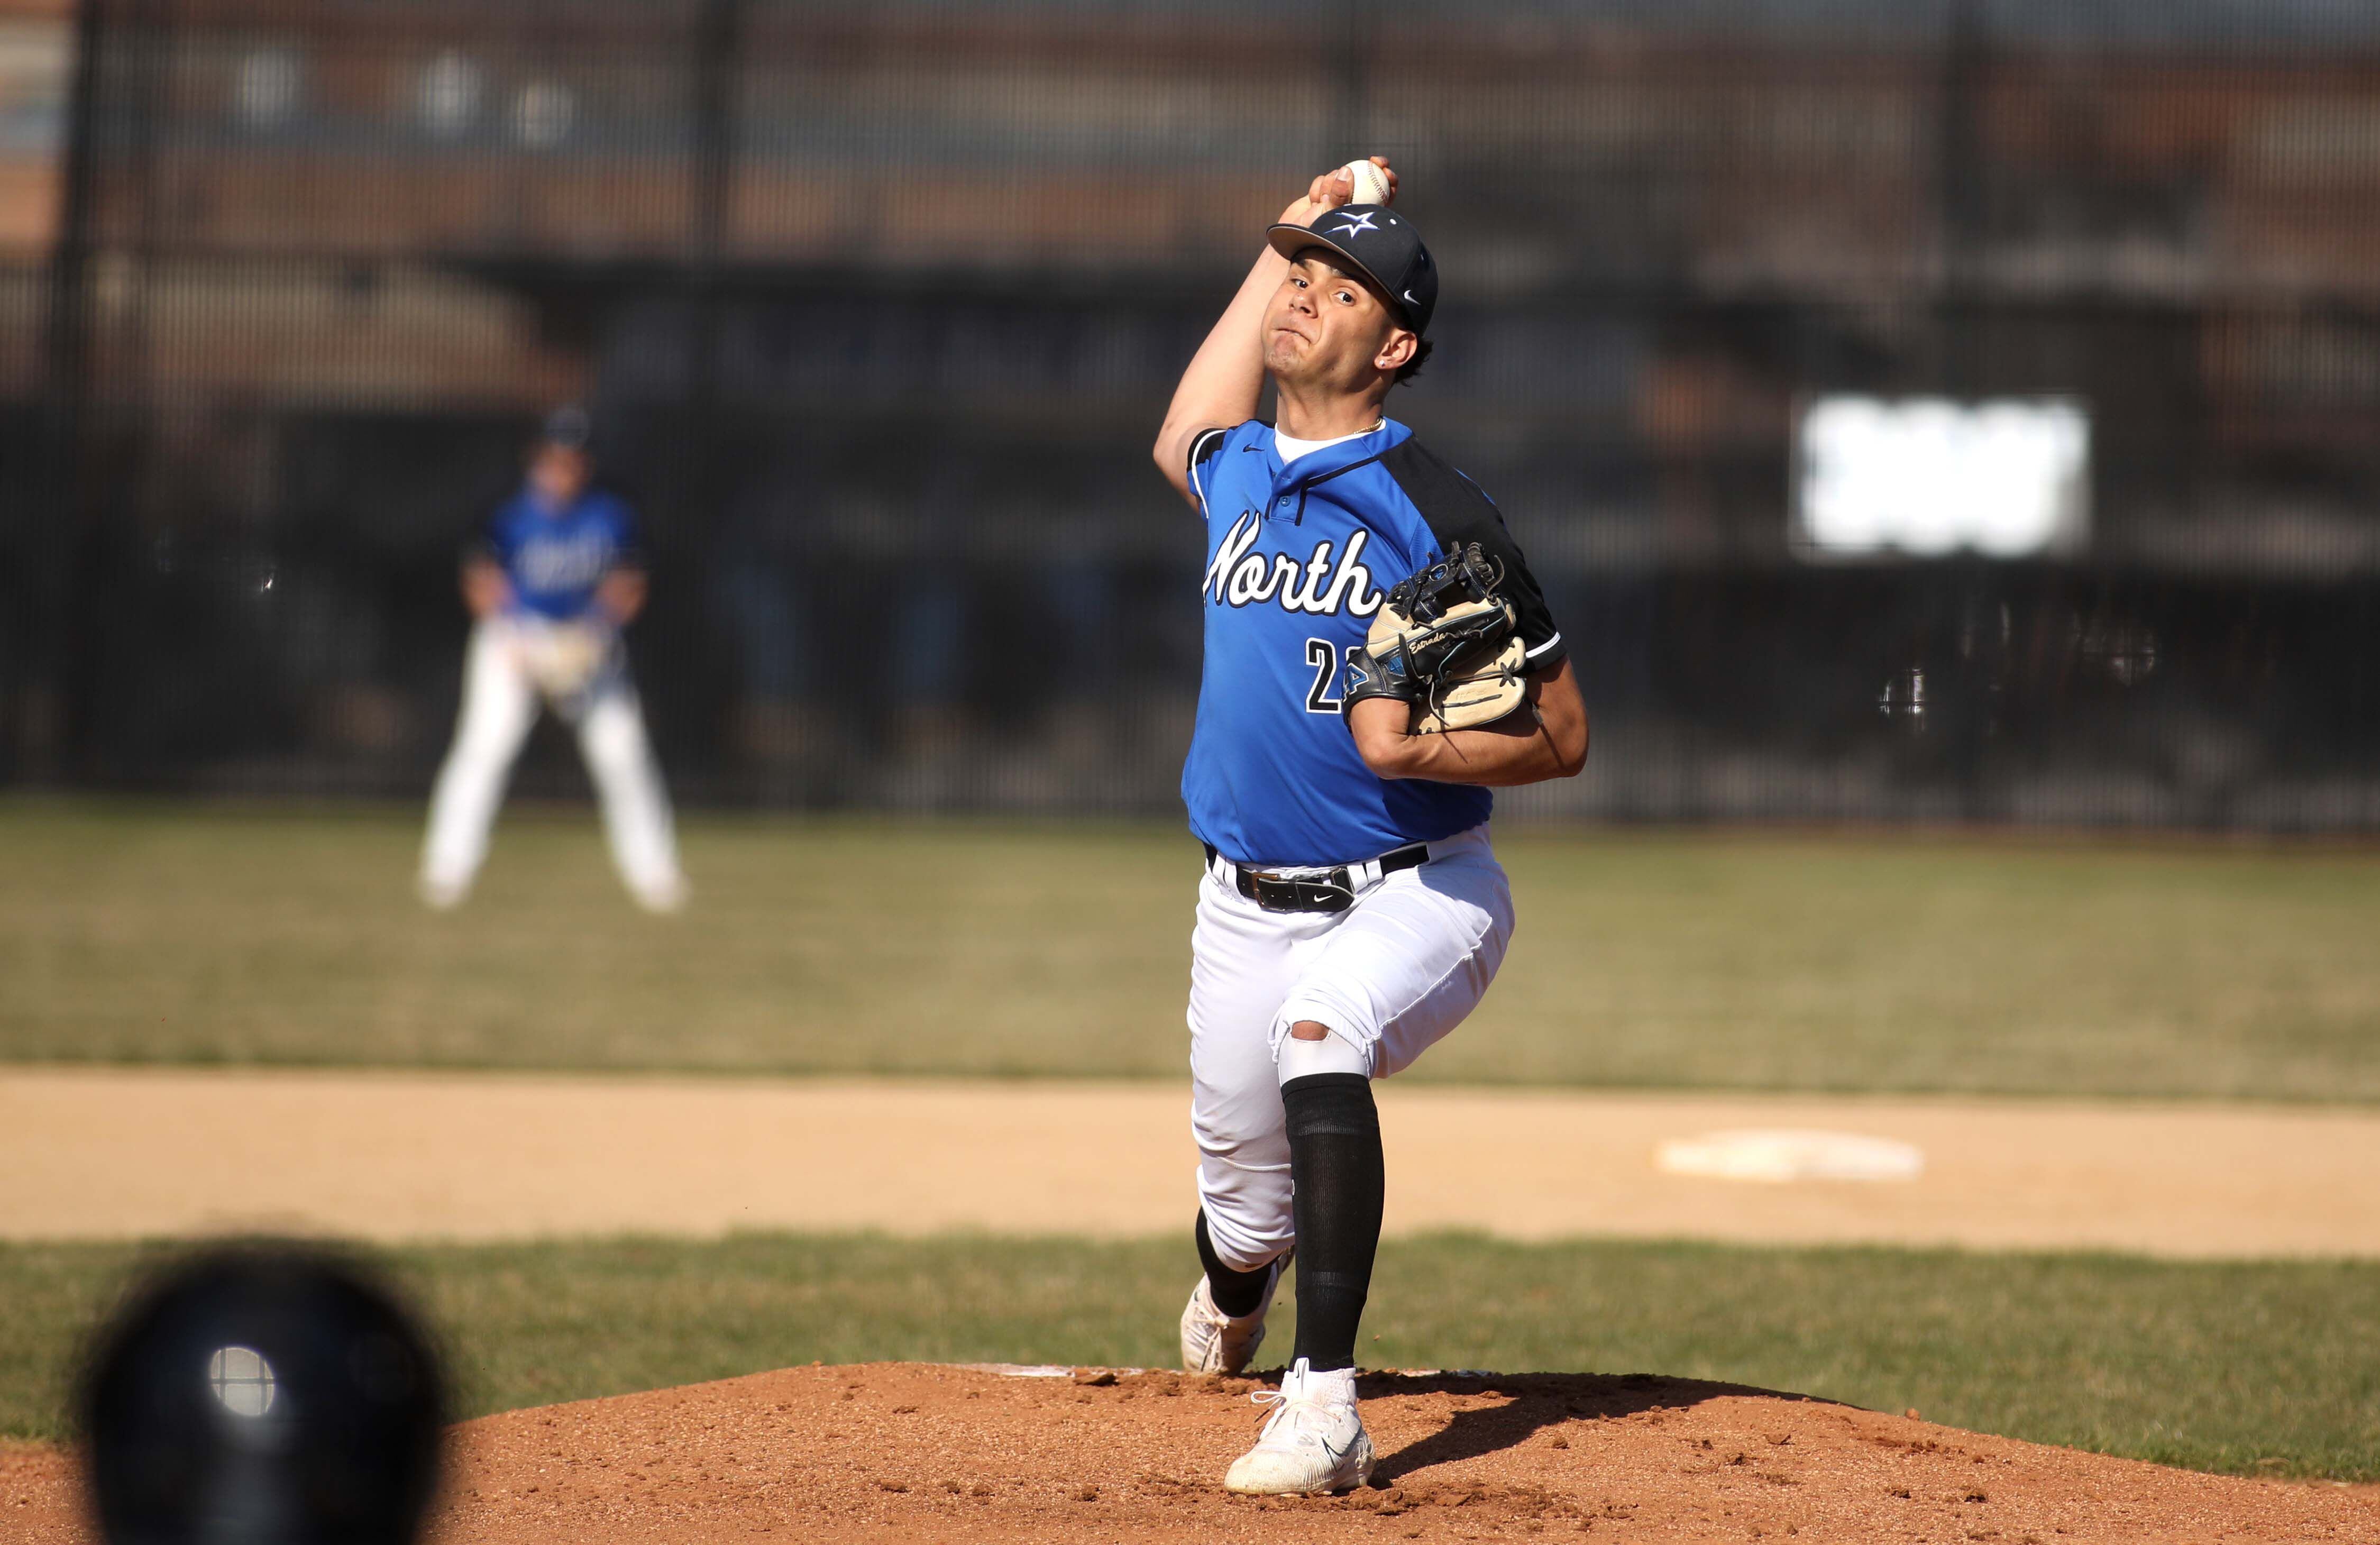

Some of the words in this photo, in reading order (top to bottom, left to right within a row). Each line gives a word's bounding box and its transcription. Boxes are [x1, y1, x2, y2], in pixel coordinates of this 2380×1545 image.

[1203, 509, 1386, 618] North
[1305, 637, 1361, 714] 2
[1408, 632, 1445, 654] Estrada
